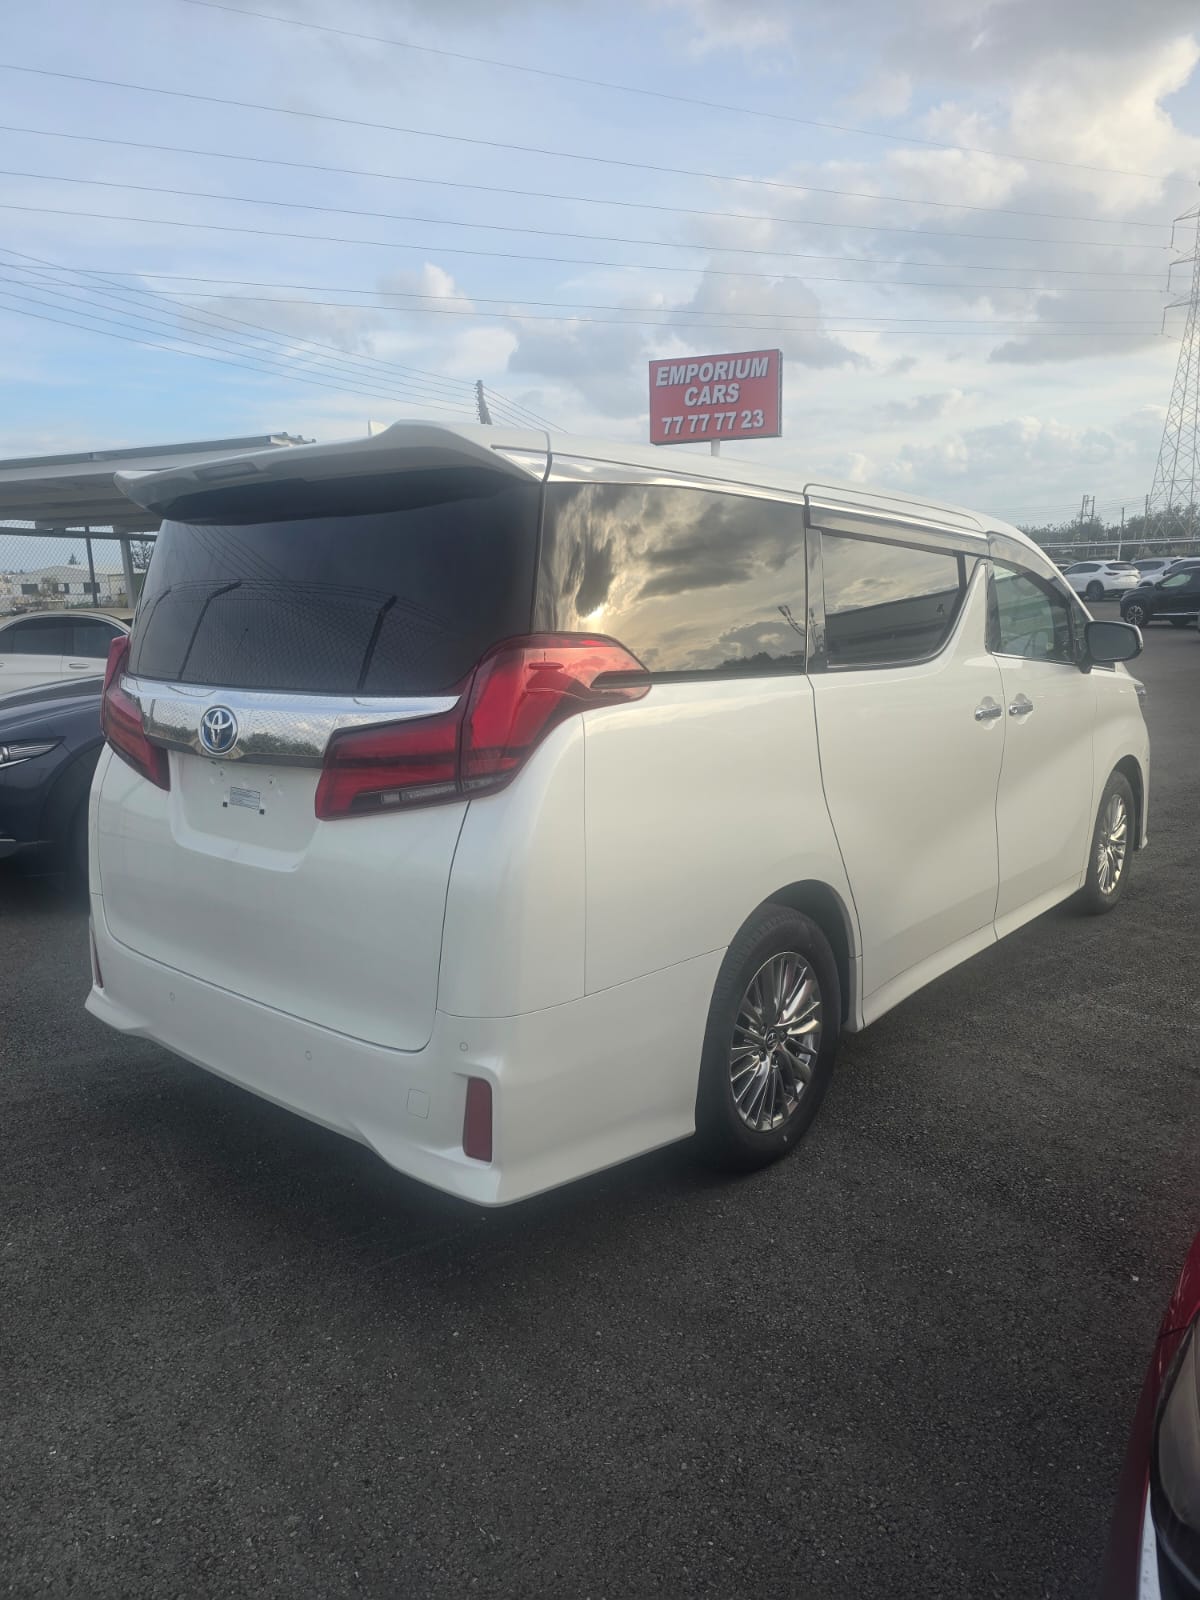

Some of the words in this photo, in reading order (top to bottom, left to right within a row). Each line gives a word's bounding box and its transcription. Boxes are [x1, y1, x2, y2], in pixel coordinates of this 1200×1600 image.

[655, 357, 769, 387] EMPORIUM
[684, 383, 740, 406] CARS
[661, 415, 684, 435] 77
[687, 413, 711, 433] 77
[714, 411, 737, 431] 77
[741, 409, 764, 429] 23
